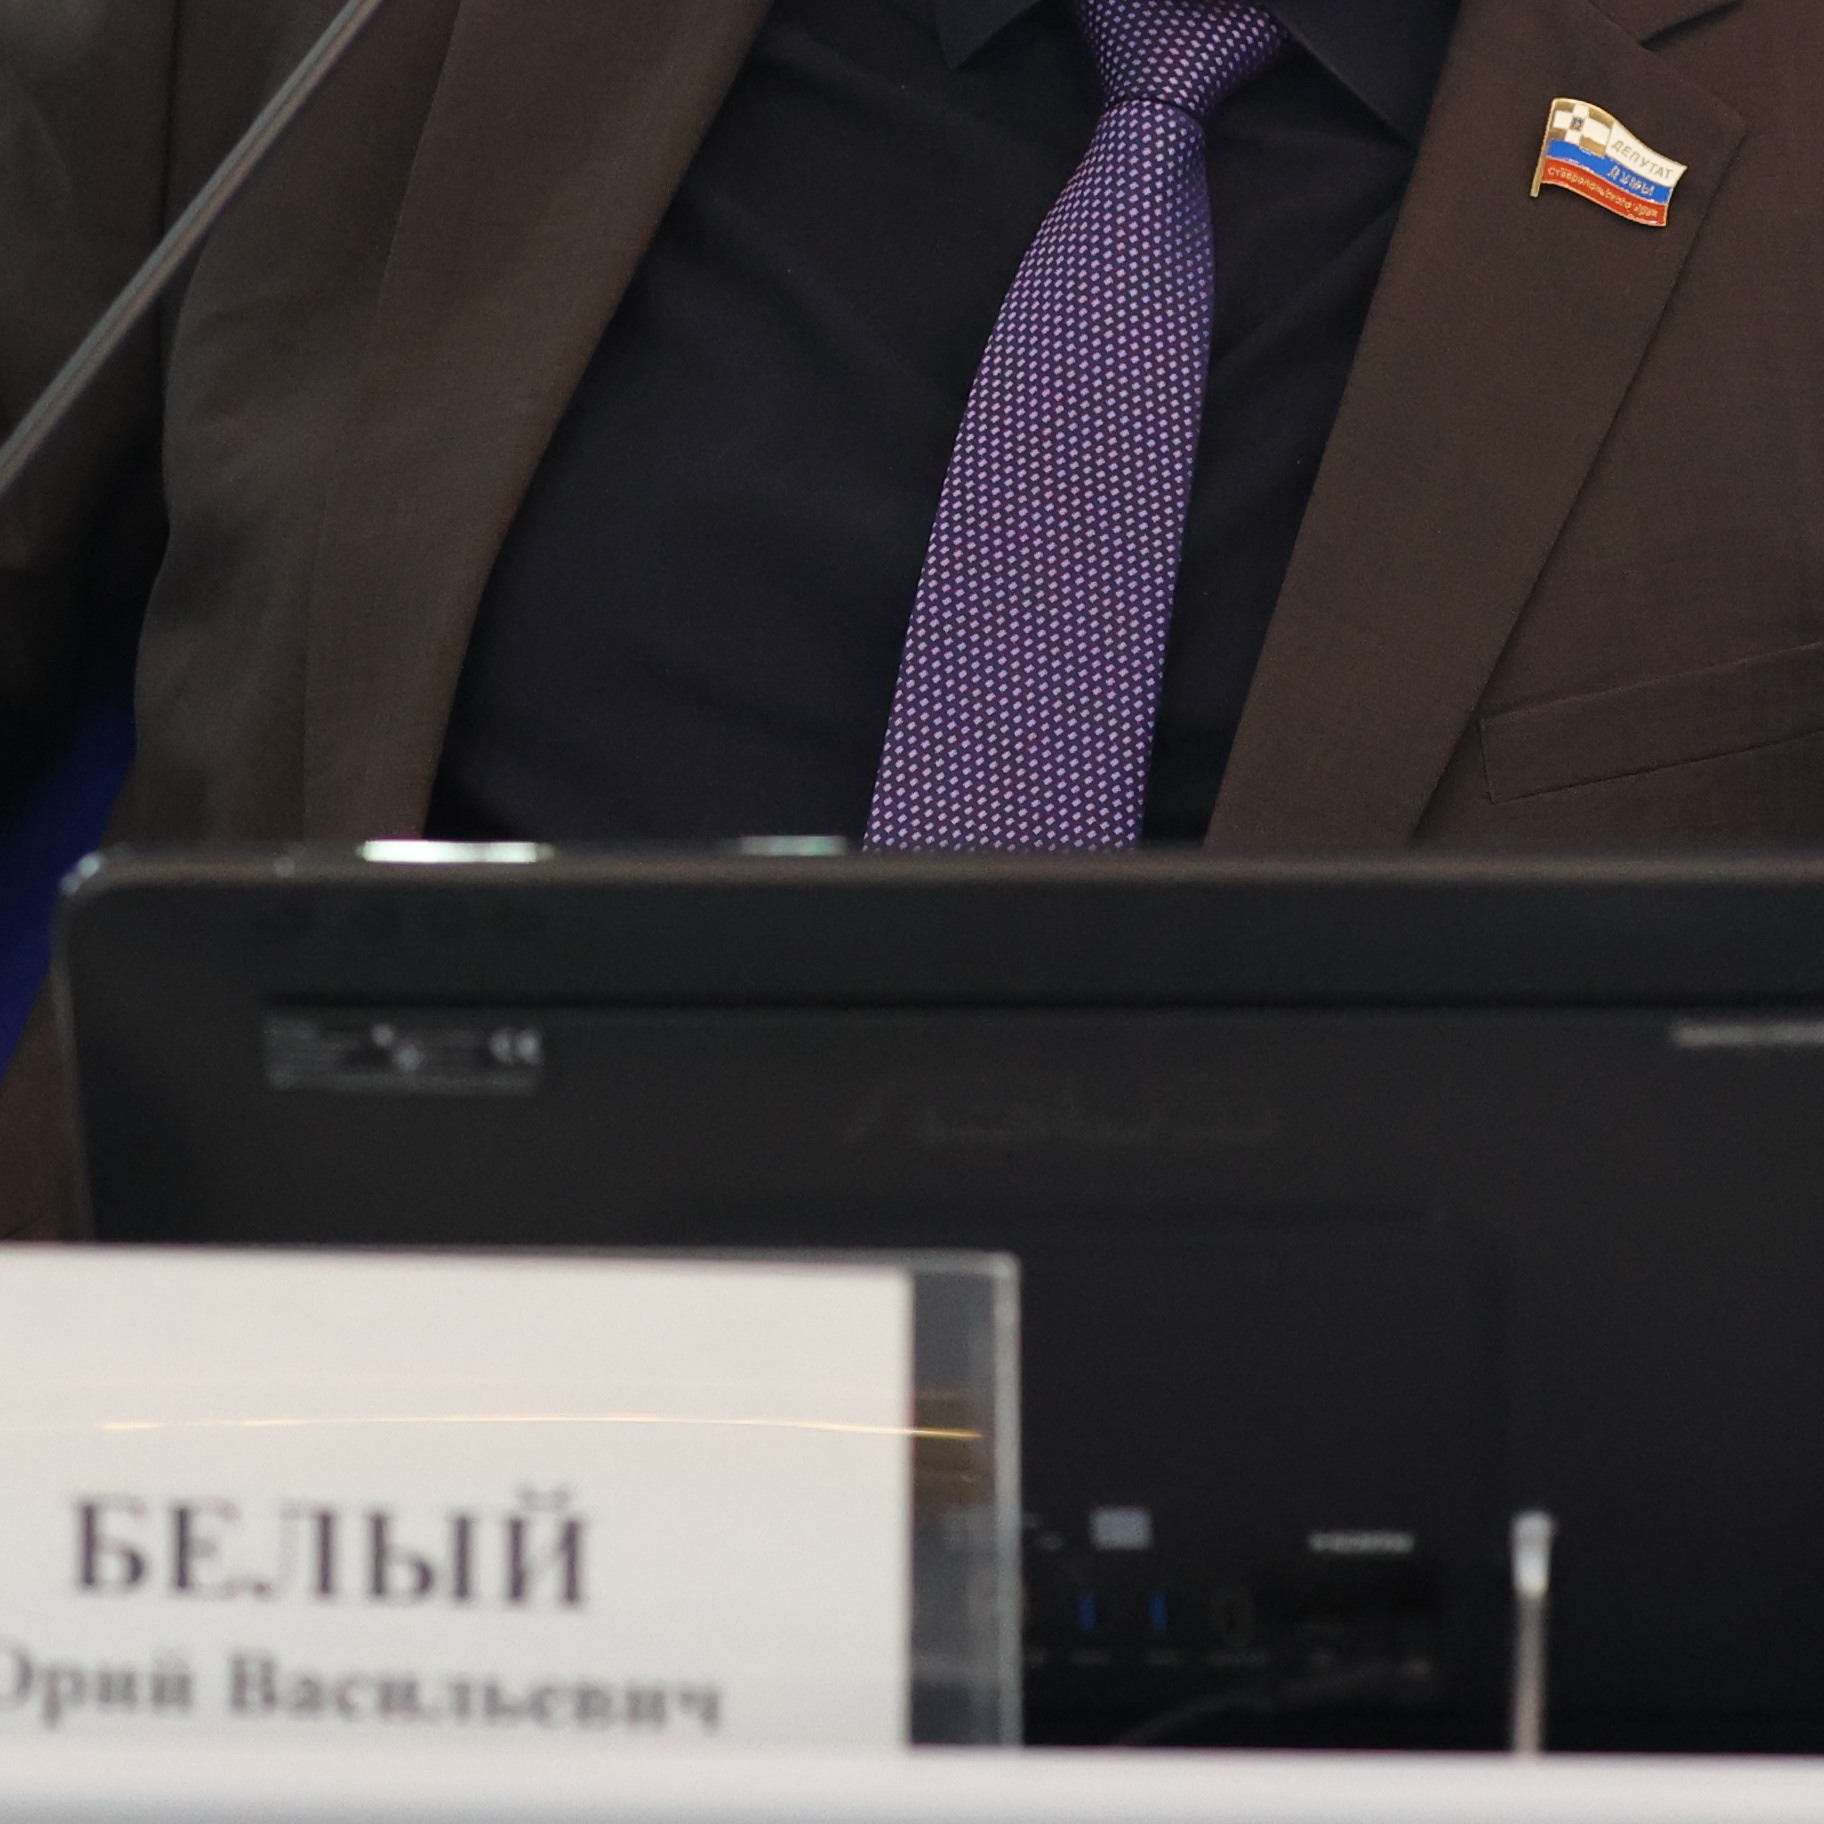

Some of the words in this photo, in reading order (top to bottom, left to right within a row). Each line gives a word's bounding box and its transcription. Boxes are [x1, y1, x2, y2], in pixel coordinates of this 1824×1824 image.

[1611, 140, 1674, 179] ДЕПУТАТ
[72, 1484, 587, 1609] БЕЛЫЙ
[228, 1648, 719, 1733] Васильевич
